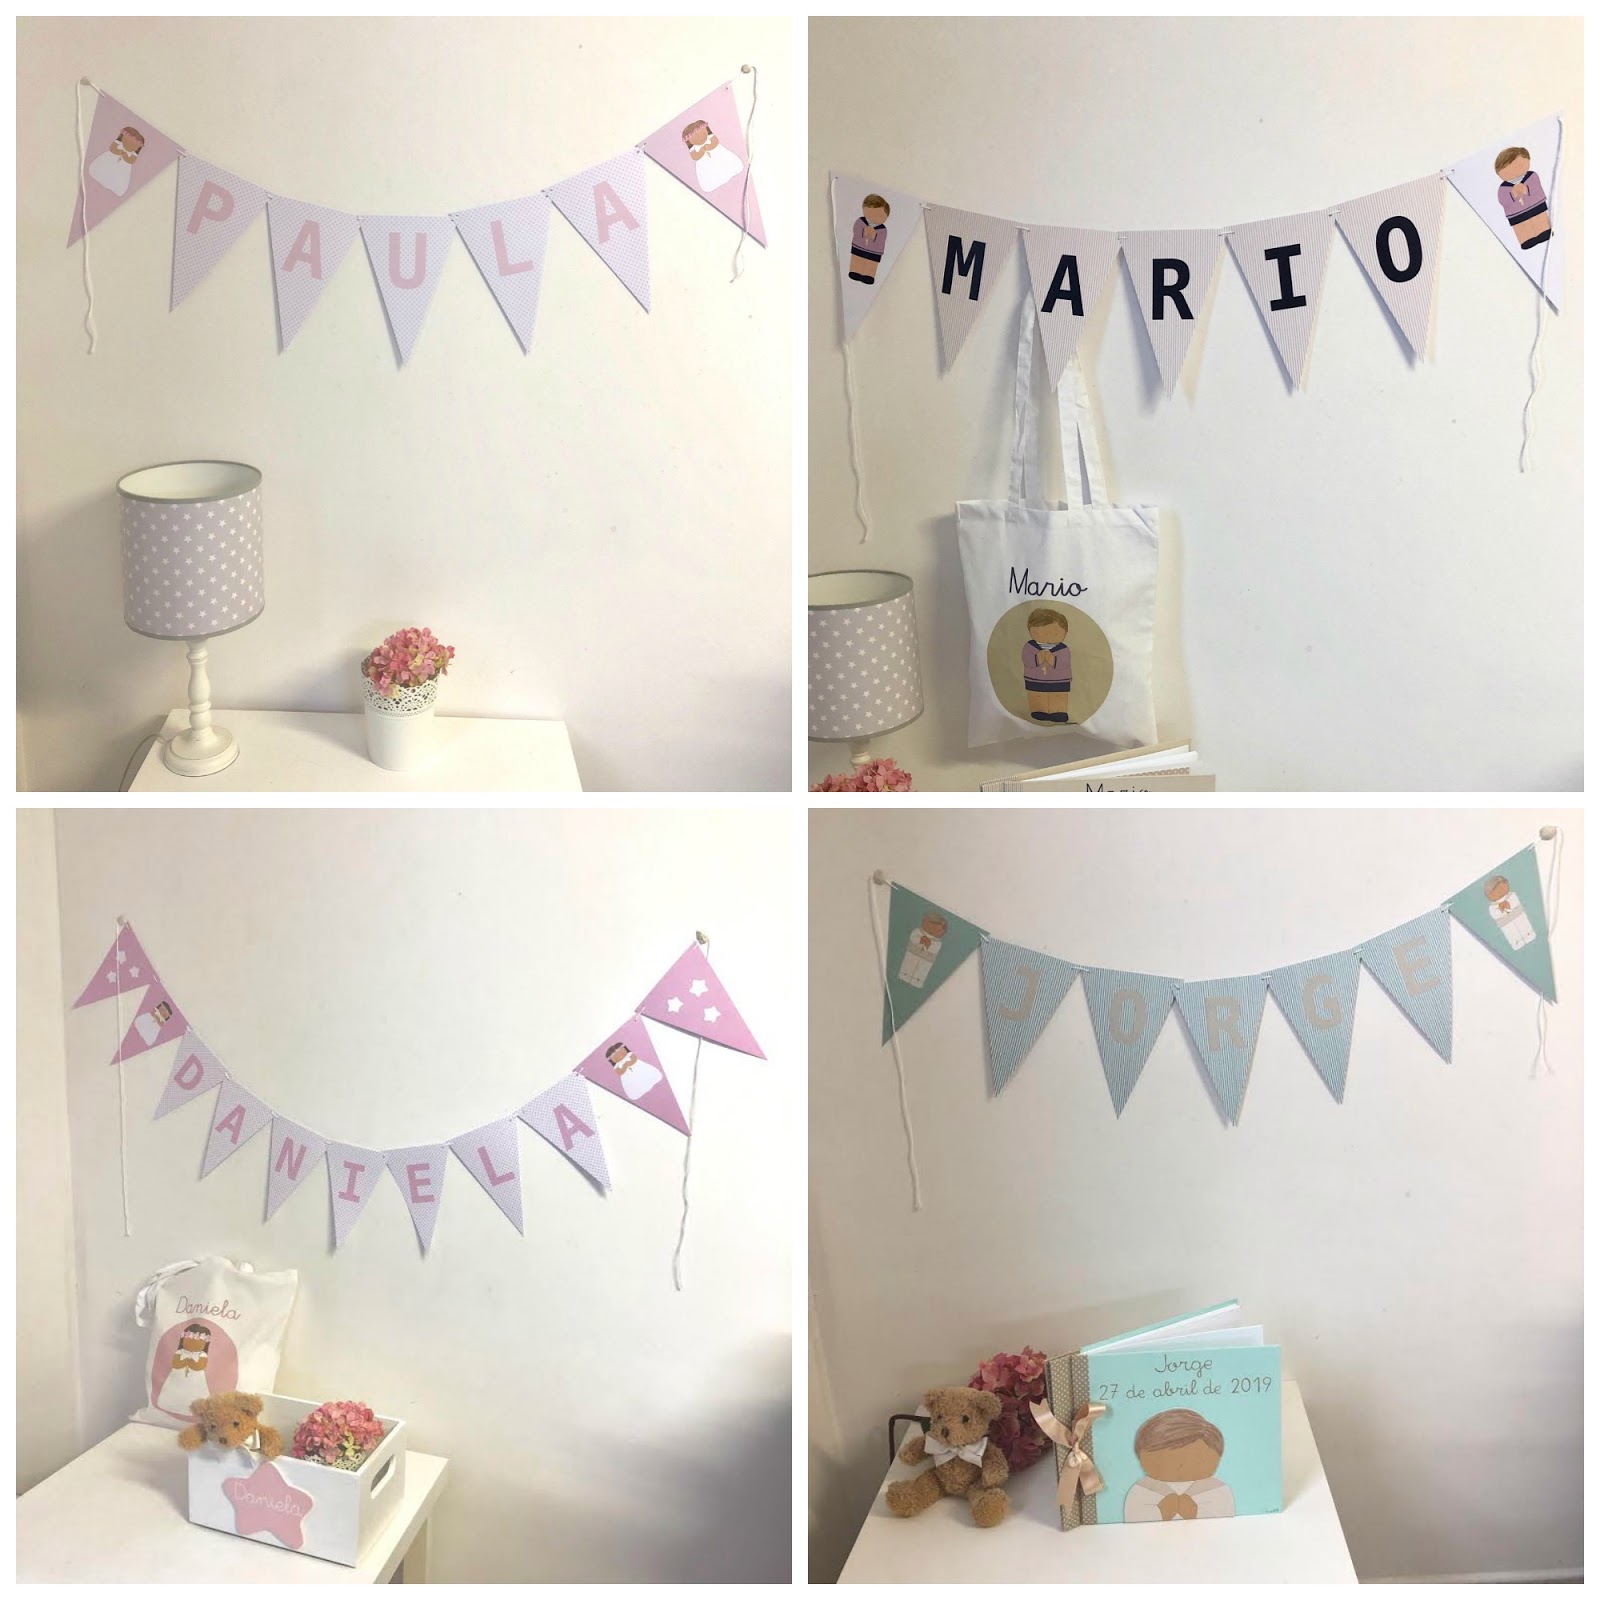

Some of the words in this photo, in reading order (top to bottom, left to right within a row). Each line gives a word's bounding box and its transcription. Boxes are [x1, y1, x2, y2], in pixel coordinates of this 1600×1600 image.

[185, 179, 641, 290] PAULA
[941, 215, 1424, 321] MARIO
[1008, 566, 1088, 597] Mario
[999, 934, 1443, 1052] JORGE
[173, 1053, 596, 1204] DANIELA
[175, 1295, 242, 1320] Daniela
[1154, 1354, 1213, 1378] Jorge
[1099, 1383, 1119, 1400] 27
[1125, 1384, 1146, 1399] de
[1152, 1379, 1198, 1398] abril
[1202, 1378, 1221, 1395] de
[1231, 1376, 1272, 1394] 2019
[234, 1481, 304, 1517] Daniela
